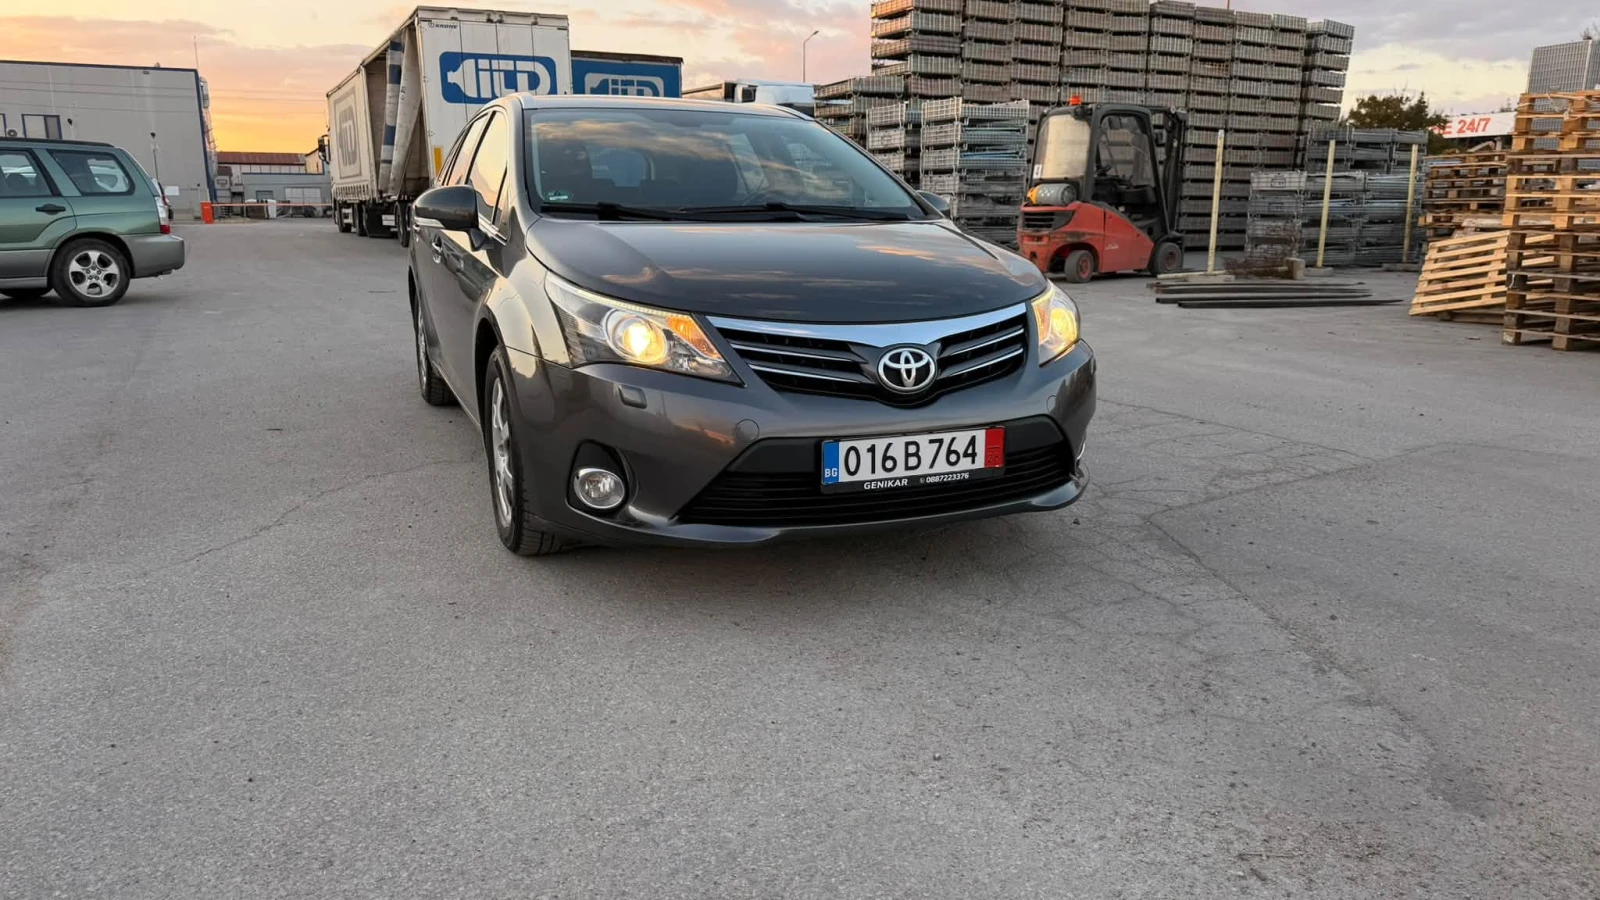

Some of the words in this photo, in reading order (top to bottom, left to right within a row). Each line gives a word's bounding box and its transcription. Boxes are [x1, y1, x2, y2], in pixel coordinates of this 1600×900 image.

[1457, 117, 1492, 134] 24/7
[844, 434, 978, 477] 016B764
[824, 467, 838, 478] BG
[863, 478, 908, 490] GENIKAR
[925, 472, 970, 484] 0887223376
